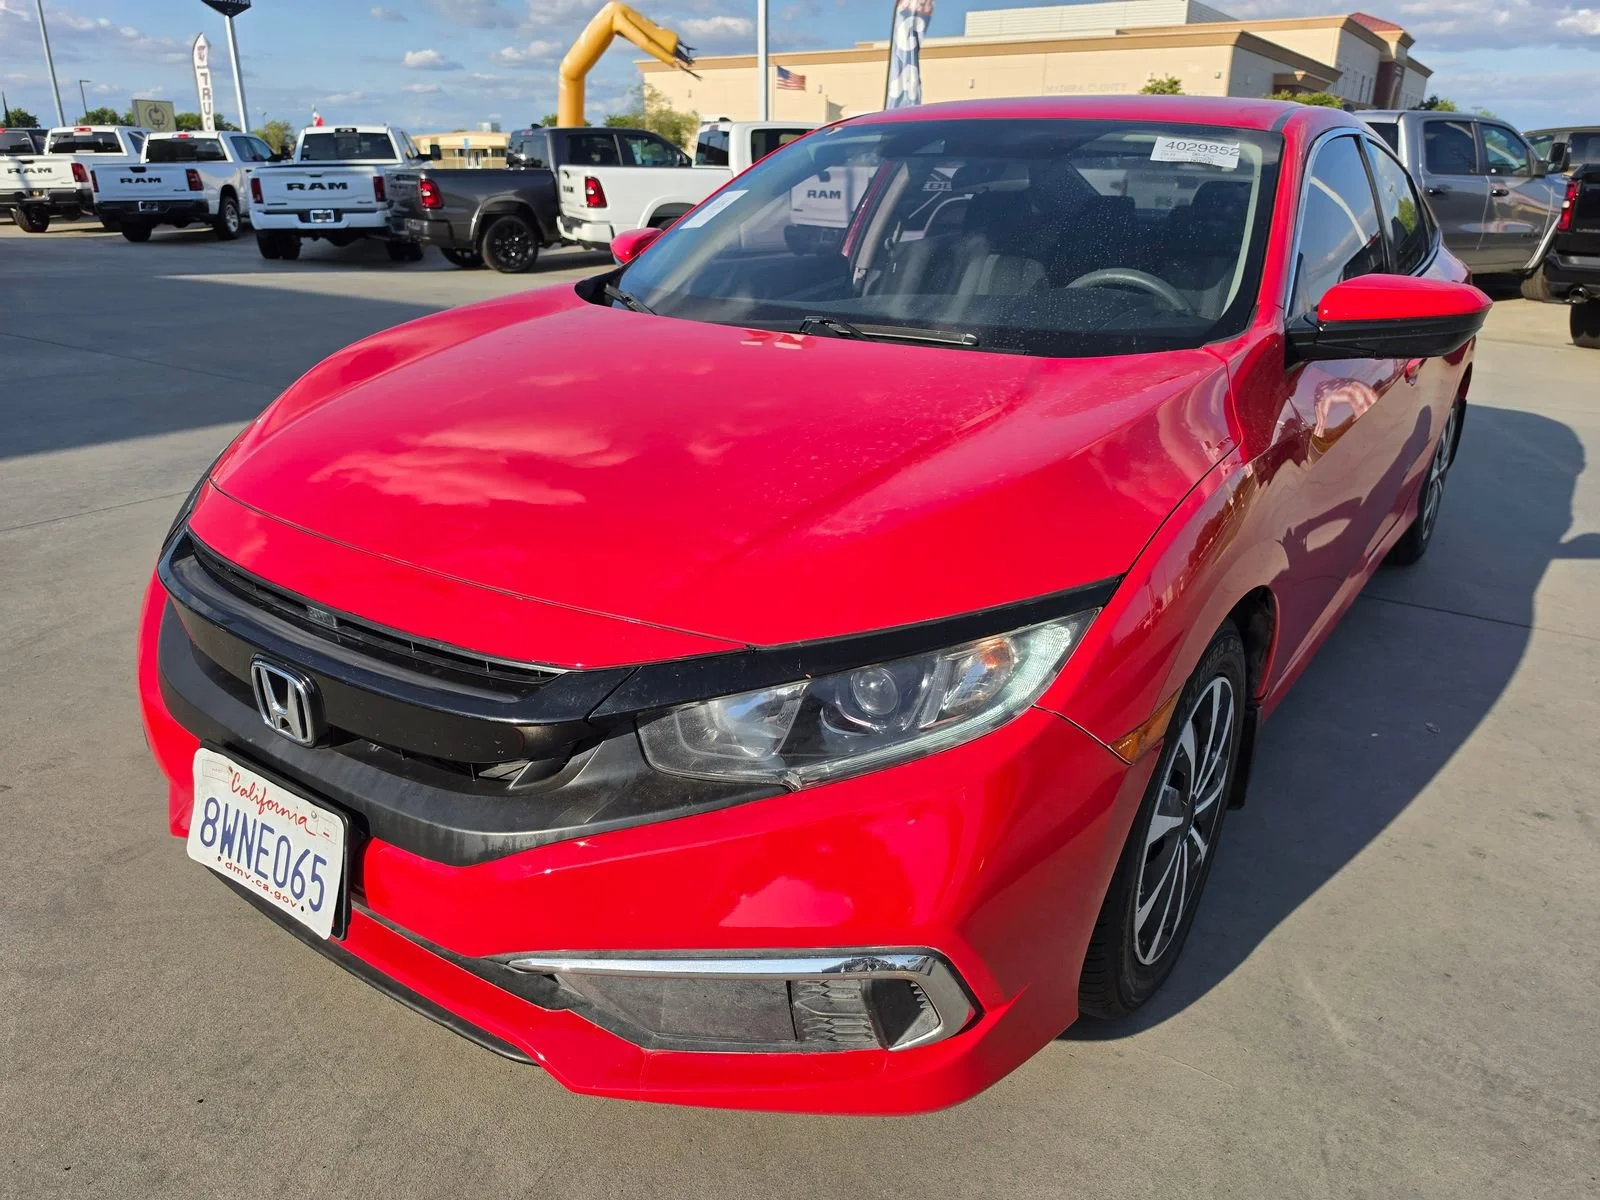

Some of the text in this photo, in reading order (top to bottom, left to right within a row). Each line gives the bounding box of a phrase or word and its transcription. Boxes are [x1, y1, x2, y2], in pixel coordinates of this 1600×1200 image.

[1165, 141, 1240, 157] 4029852
[286, 182, 349, 191] RAM
[807, 190, 841, 199] RAM
[231, 771, 316, 837] California
[199, 796, 328, 912] 8WNE065
[225, 861, 298, 909] dmv.ca.gov
